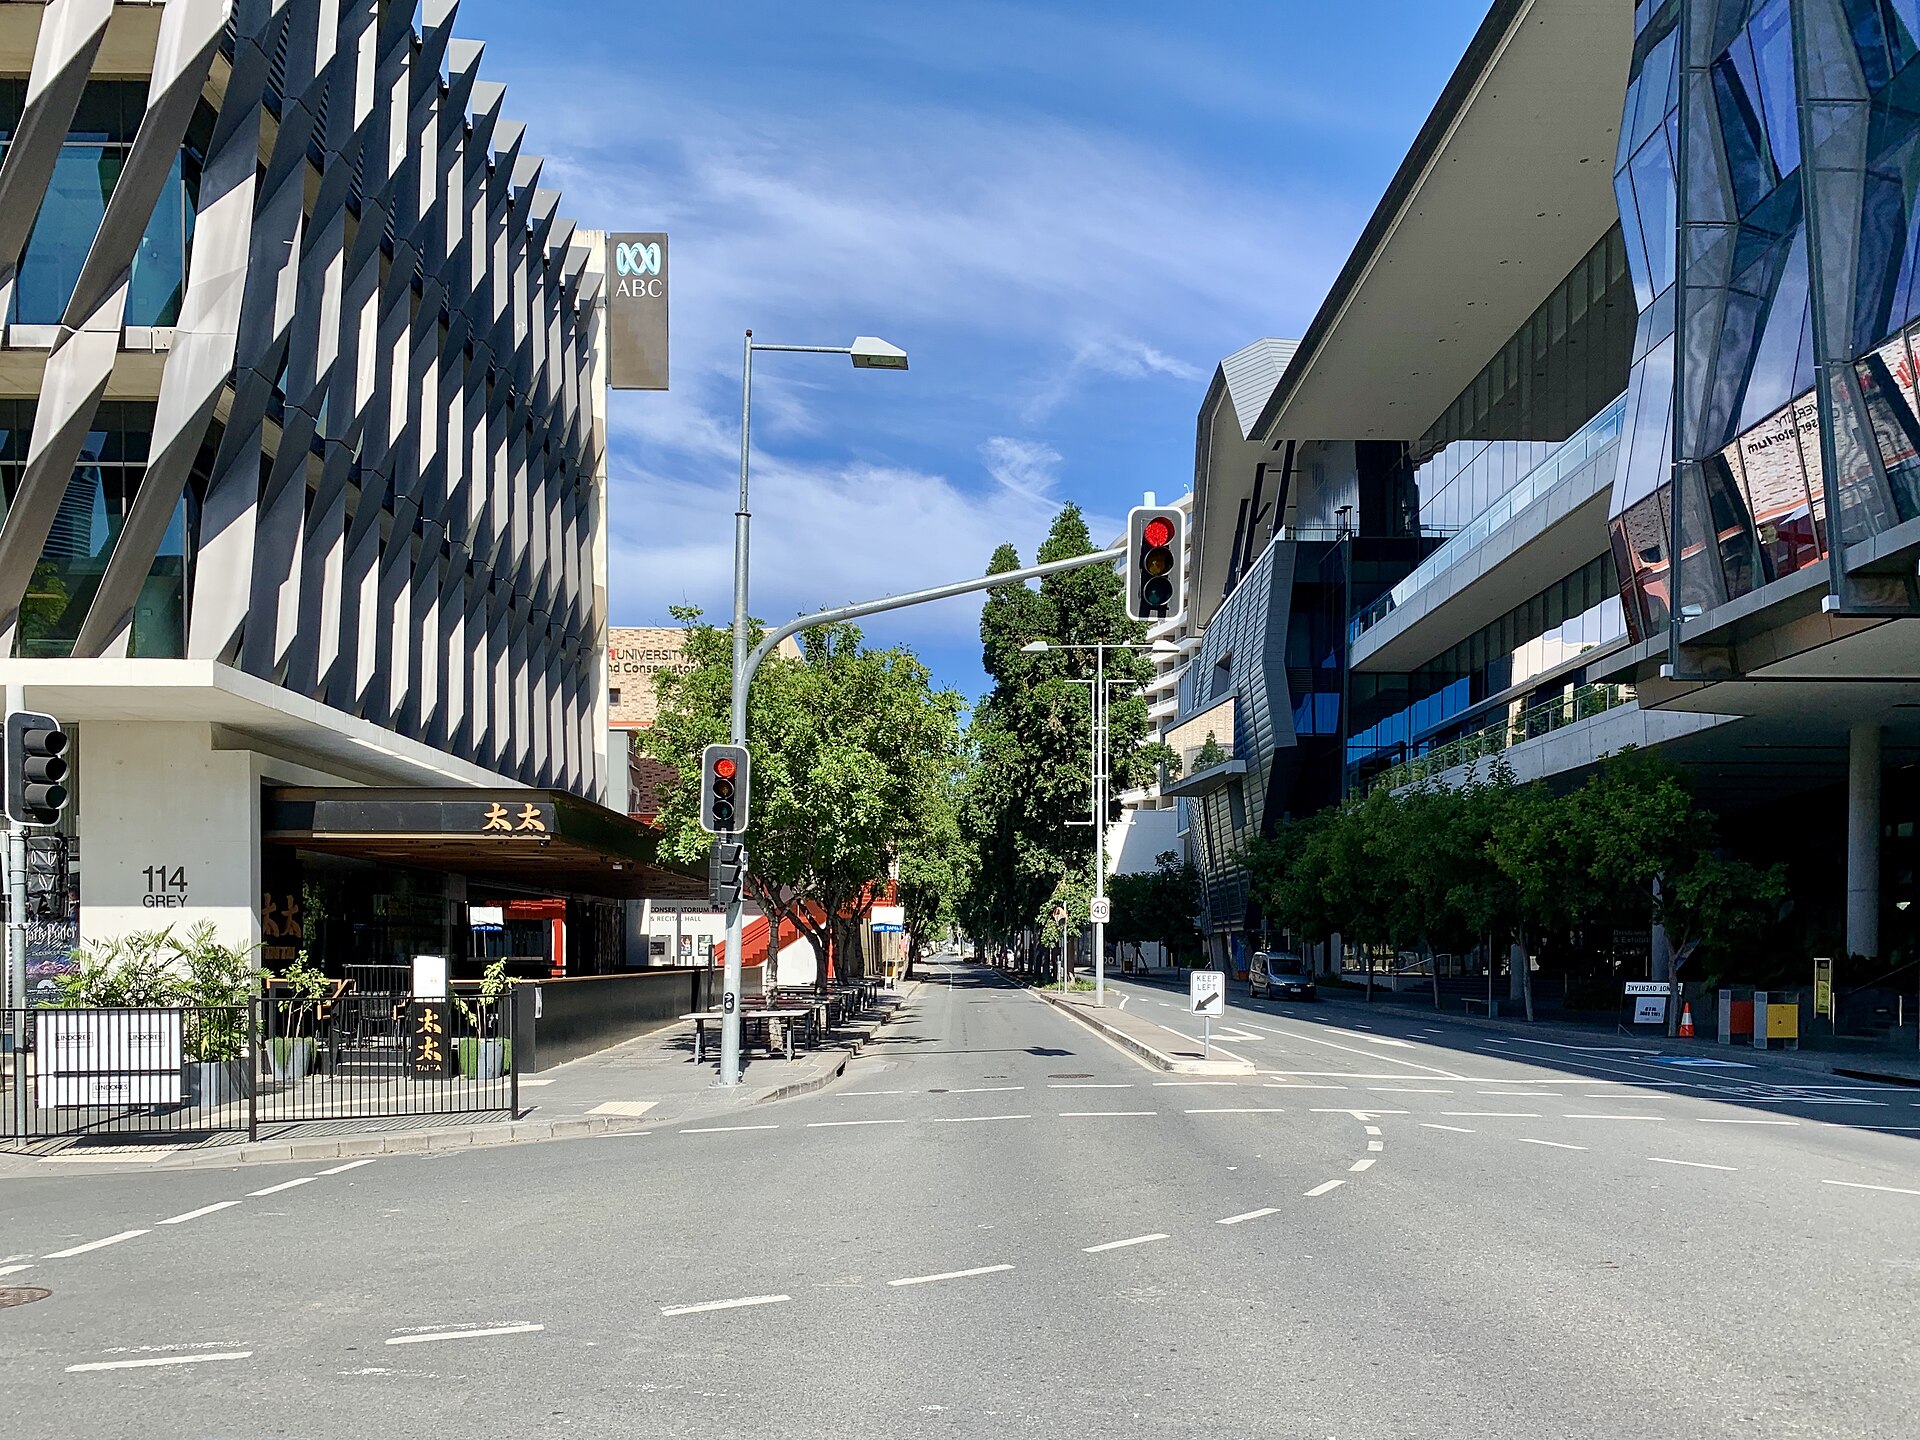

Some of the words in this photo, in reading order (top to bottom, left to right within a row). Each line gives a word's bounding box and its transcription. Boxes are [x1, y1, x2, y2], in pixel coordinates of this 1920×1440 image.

[615, 279, 663, 298] ABC
[616, 649, 685, 660] UNIVERSITY
[481, 802, 546, 832] 太太
[142, 865, 188, 892] 114
[142, 894, 188, 908] GREY
[1094, 905, 1107, 915] 40
[129, 1033, 162, 1041] LINDORE
